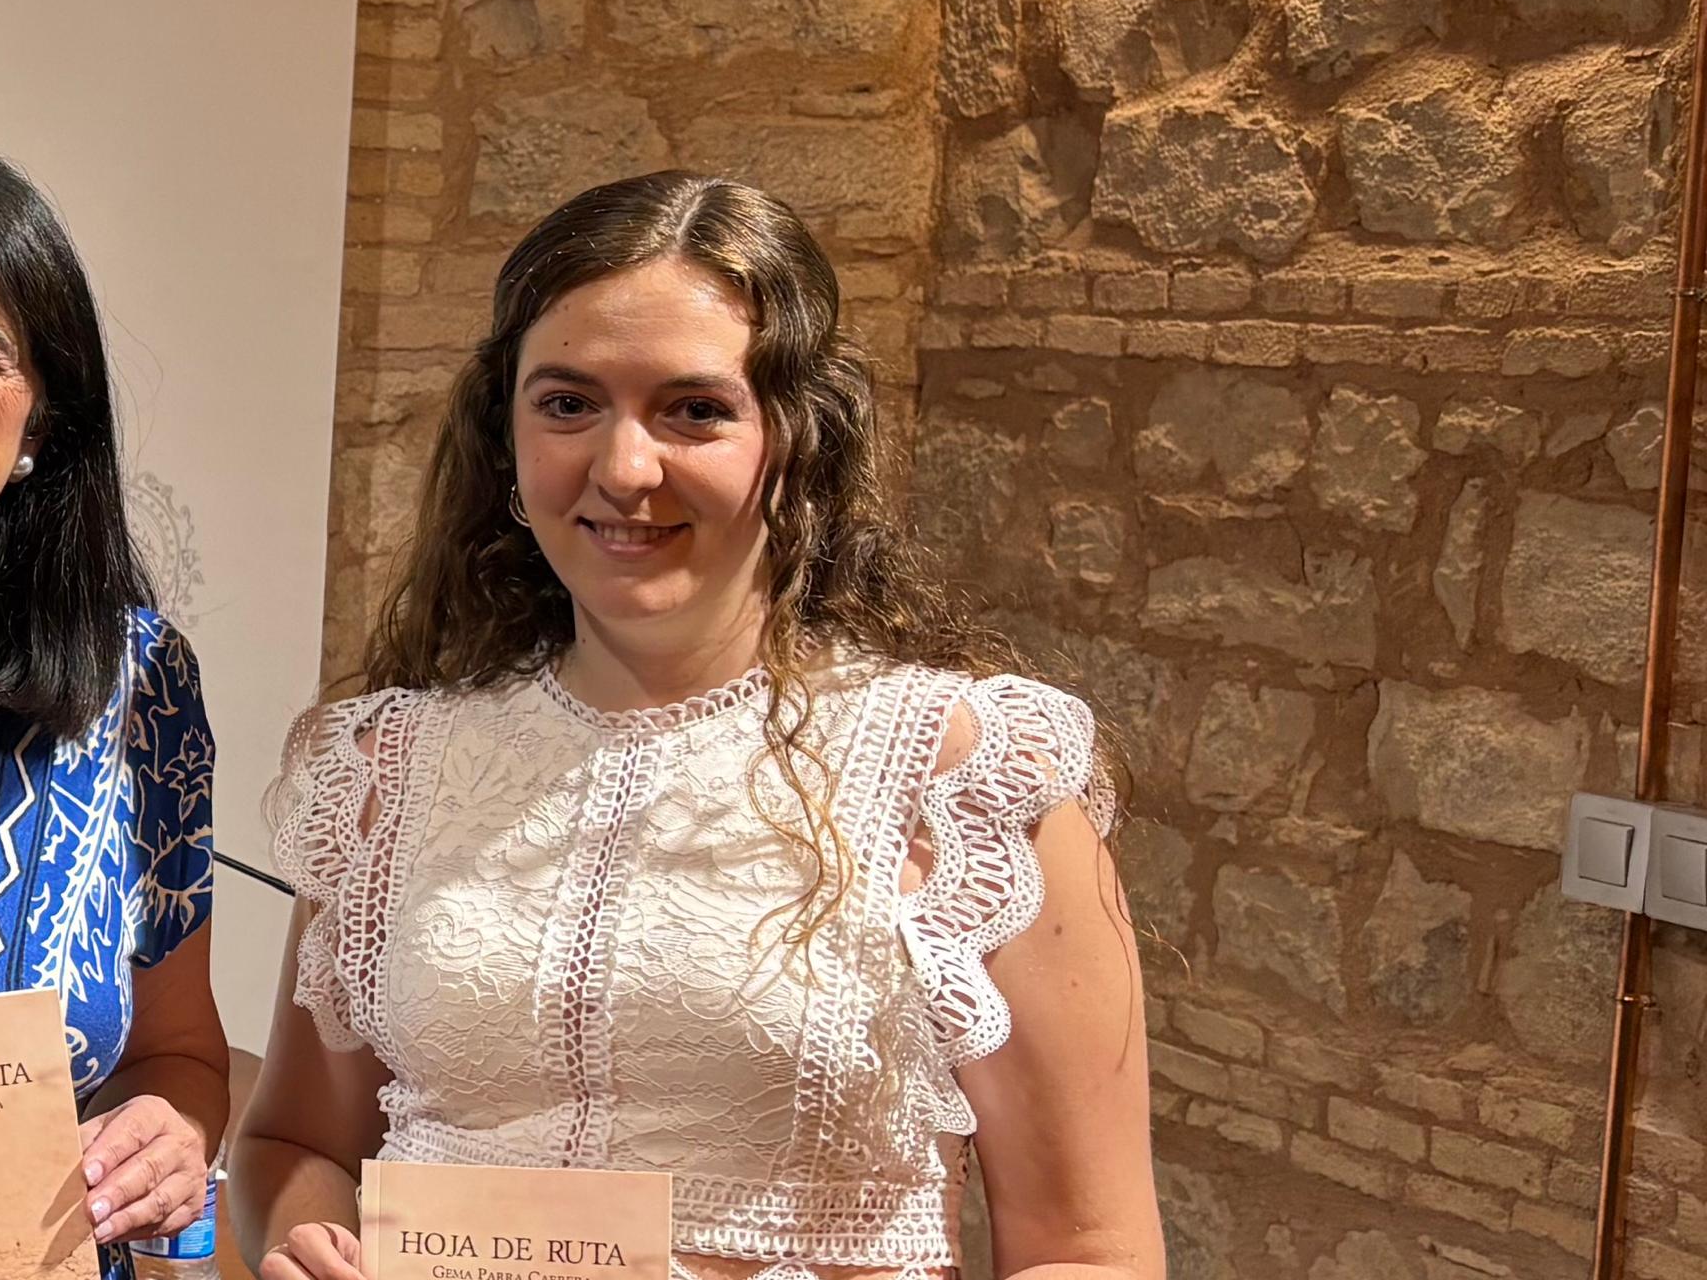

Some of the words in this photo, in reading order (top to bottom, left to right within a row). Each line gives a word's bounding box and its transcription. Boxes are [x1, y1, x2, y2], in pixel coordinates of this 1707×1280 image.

[400, 1231, 478, 1257] HOJA
[492, 1237, 533, 1261] DE
[547, 1240, 626, 1266] RUTA
